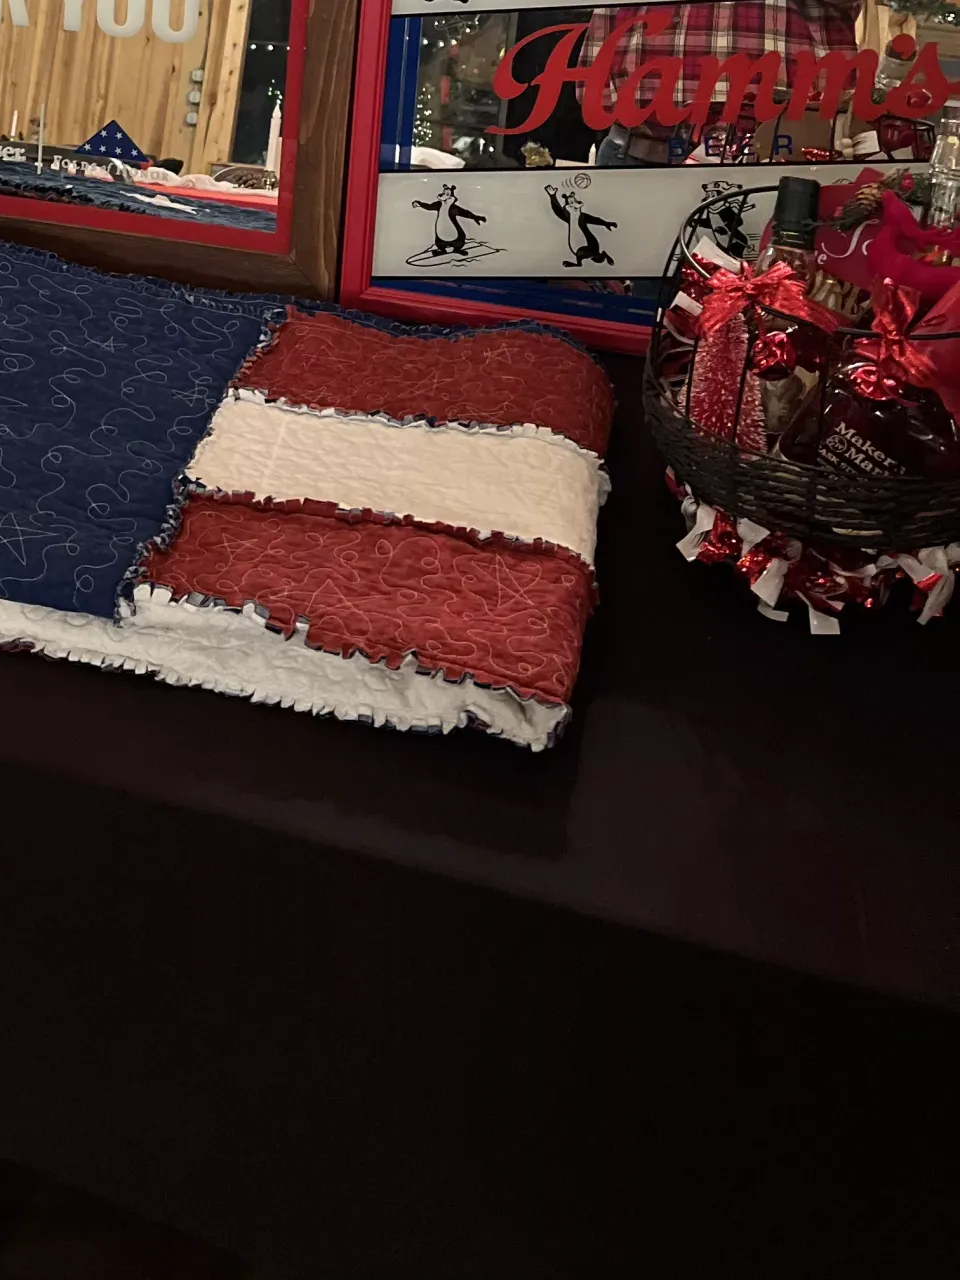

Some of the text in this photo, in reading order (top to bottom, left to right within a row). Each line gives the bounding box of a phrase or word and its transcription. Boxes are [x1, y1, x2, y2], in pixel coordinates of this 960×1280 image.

[485, 8, 959, 136] Hamm's
[667, 134, 794, 159] BEER
[833, 421, 907, 476] Makers
